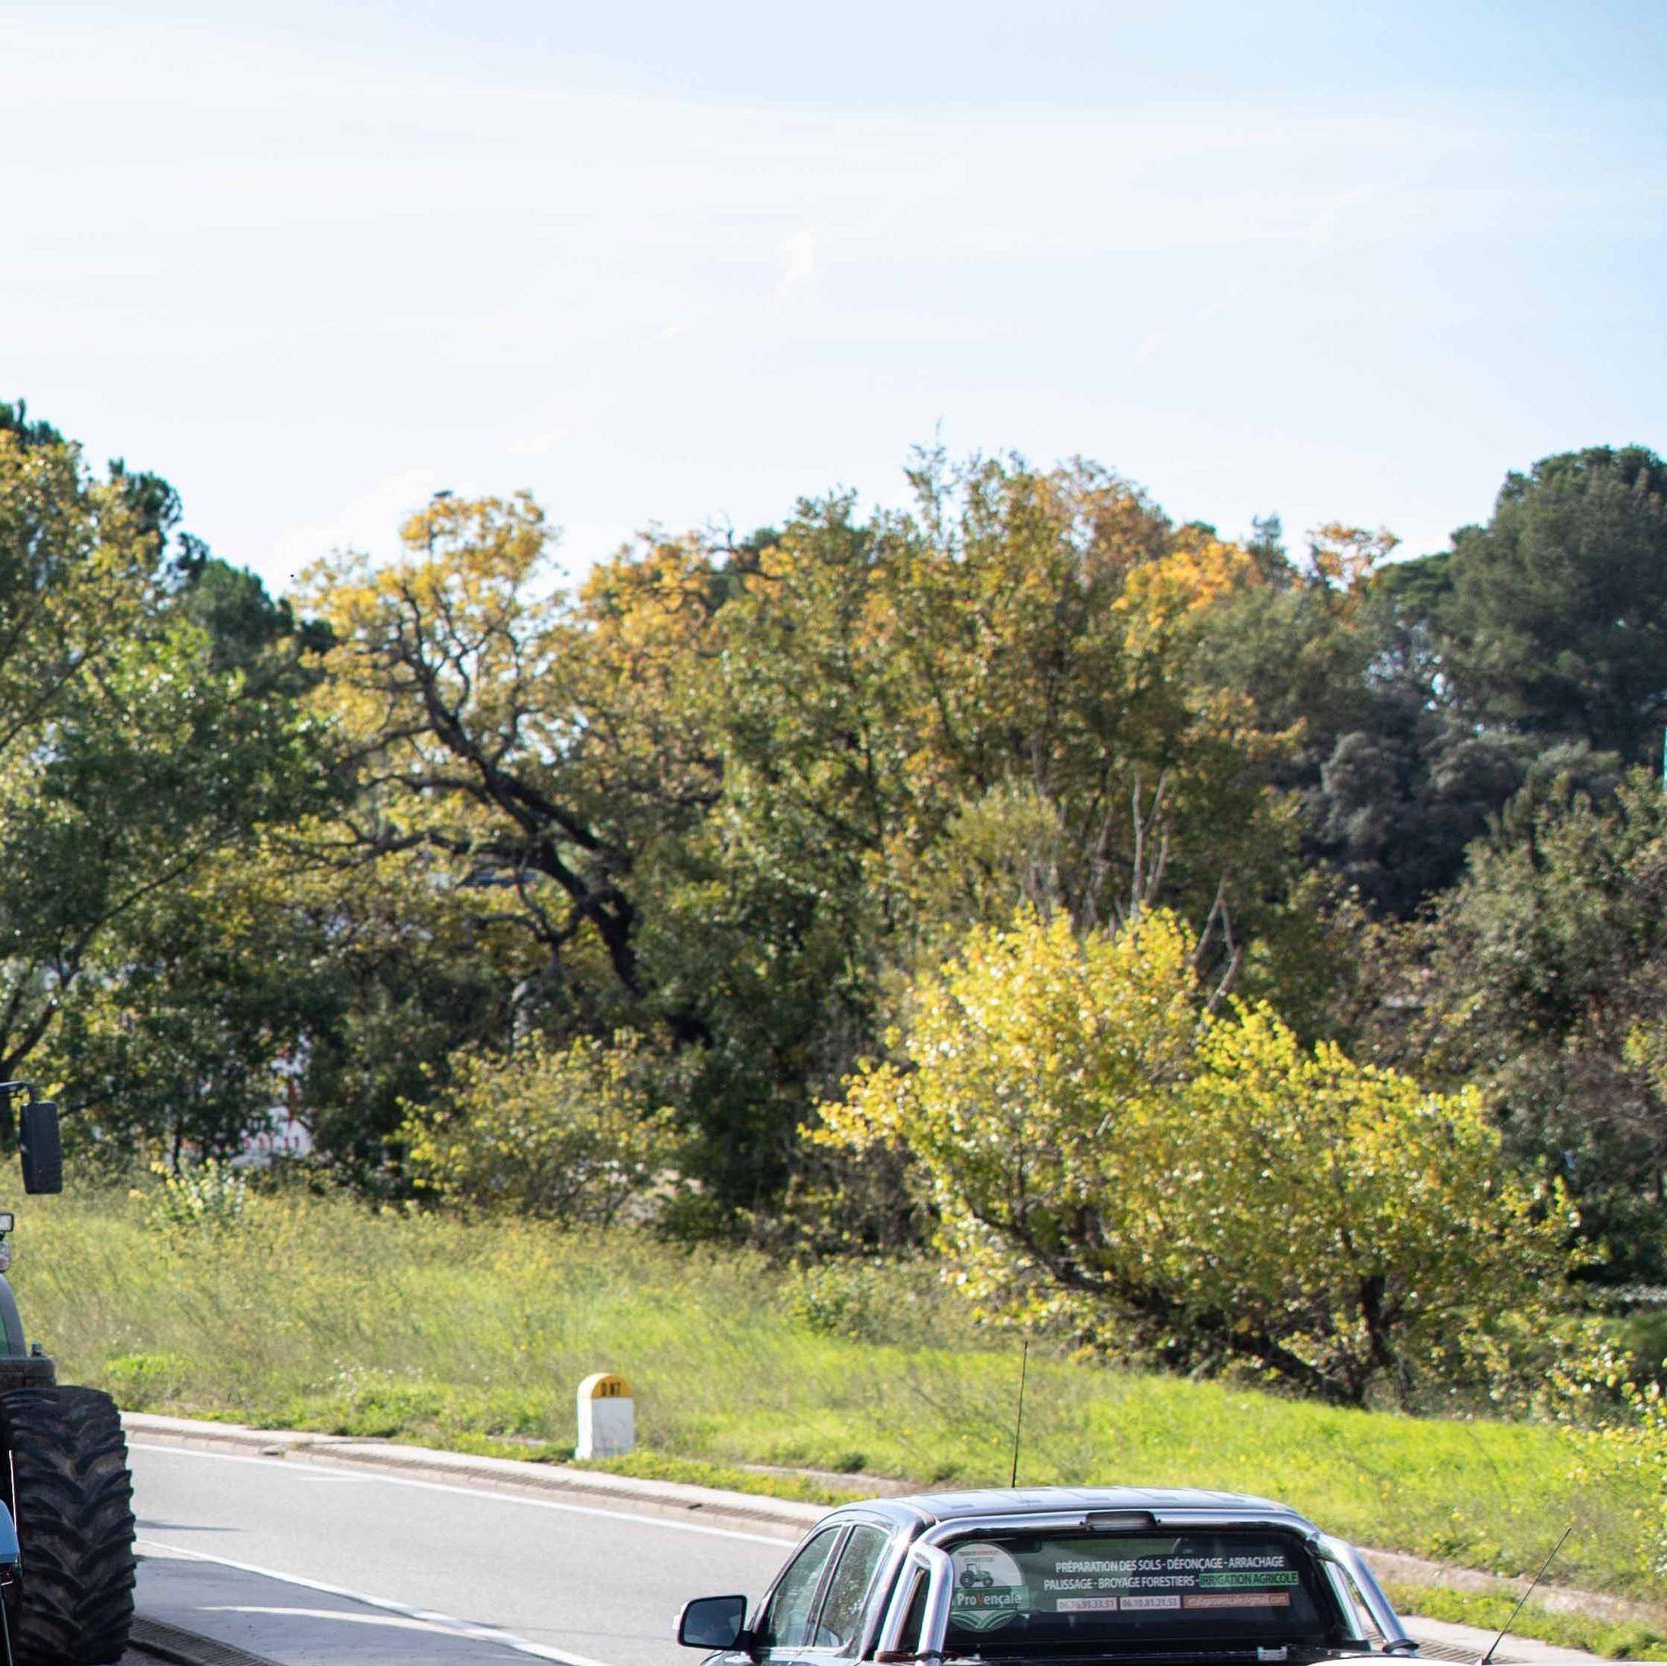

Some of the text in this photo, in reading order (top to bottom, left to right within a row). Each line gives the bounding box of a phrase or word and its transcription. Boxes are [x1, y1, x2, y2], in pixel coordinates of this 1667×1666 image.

[1055, 1560, 1118, 1573] PRÉPARATION
[1119, 1560, 1137, 1571] DES
[1138, 1559, 1162, 1571] SOLS
[1228, 1556, 1285, 1568] ARRACHAGE
[1044, 1579, 1093, 1590] PALISSAGE
[1099, 1577, 1140, 1588] BROYAGE
[1142, 1575, 1195, 1587] FORESTIERS
